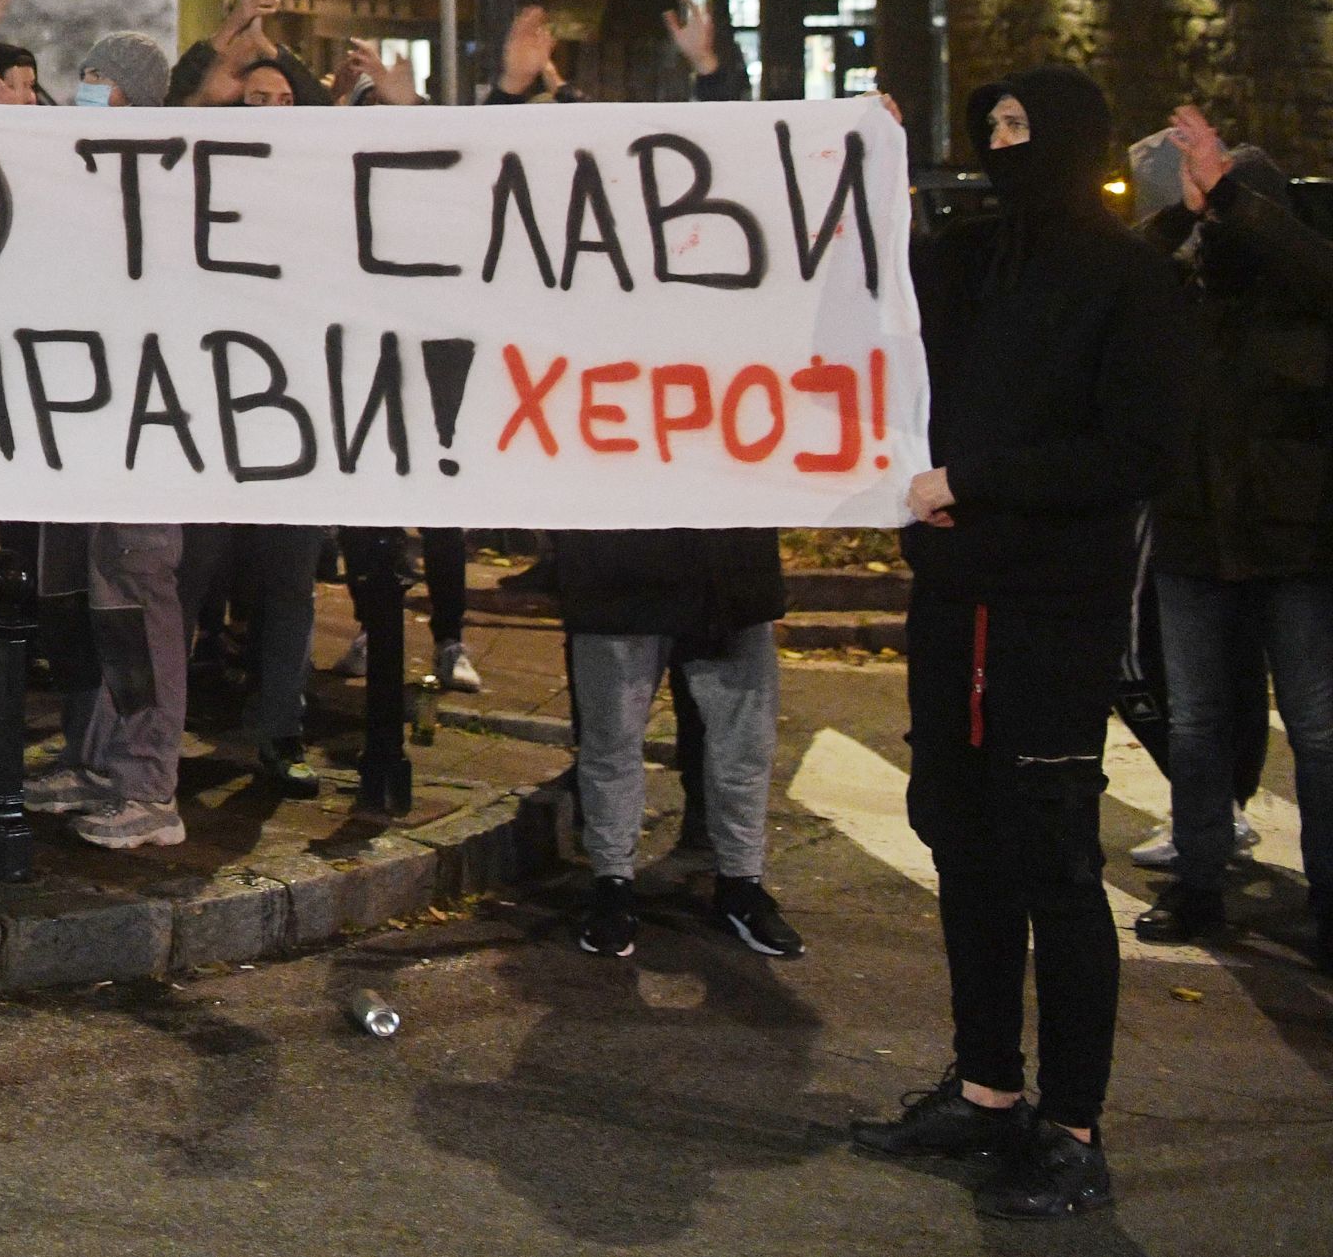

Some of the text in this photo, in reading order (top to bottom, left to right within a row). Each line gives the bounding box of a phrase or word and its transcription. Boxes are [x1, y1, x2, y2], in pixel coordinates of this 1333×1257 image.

[75, 137, 282, 281] ТЕ
[353, 120, 880, 298] СЛАВИ
[495, 344, 891, 473] ХЕРОЈ!
